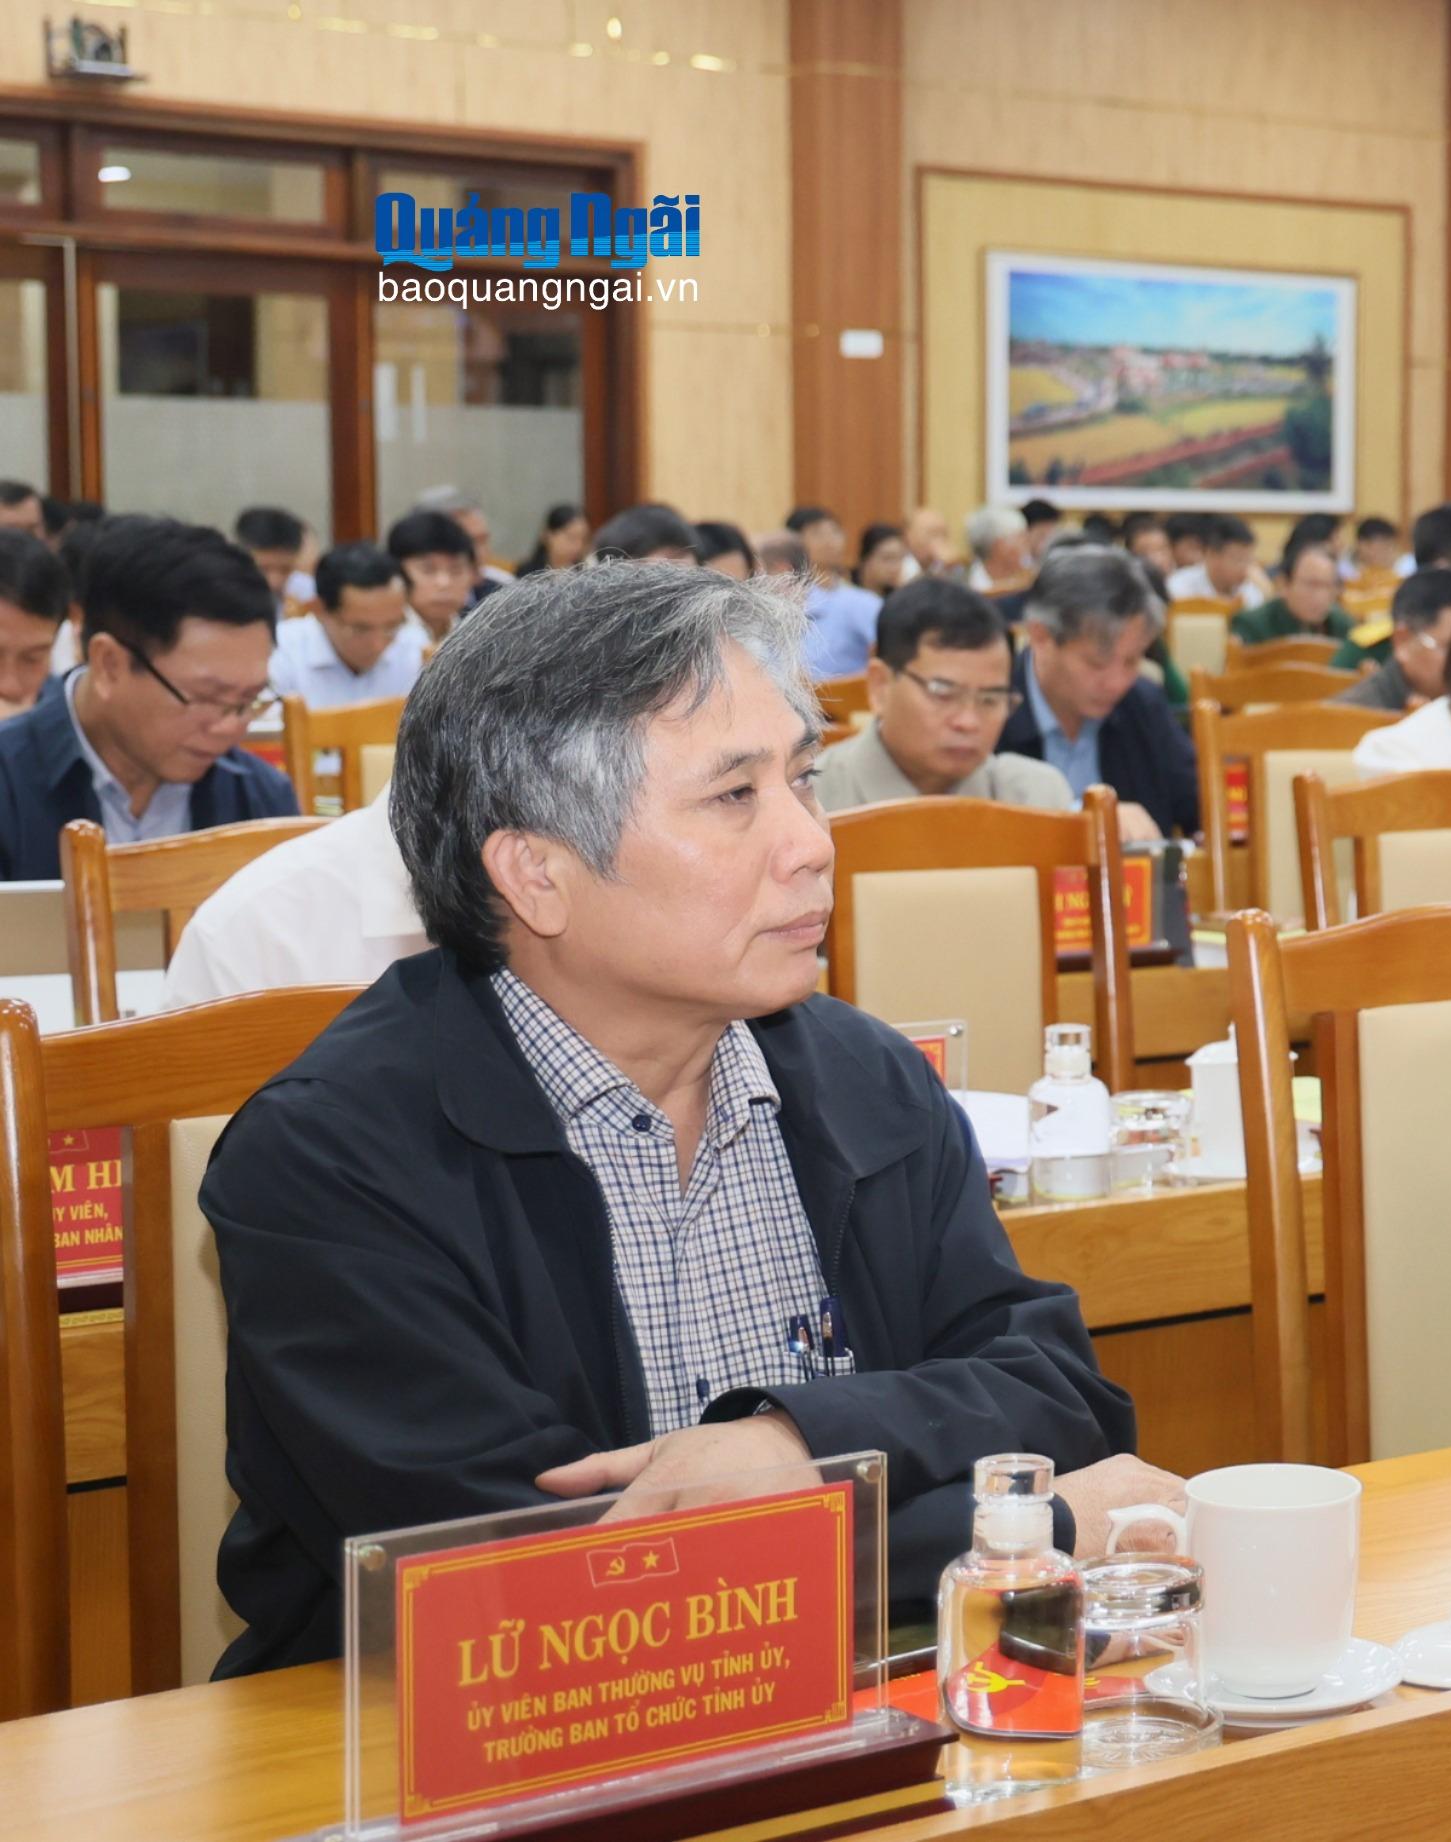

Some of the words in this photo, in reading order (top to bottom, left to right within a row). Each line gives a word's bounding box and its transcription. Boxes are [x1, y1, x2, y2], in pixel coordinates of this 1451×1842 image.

[70, 1200, 108, 1221] VIÊN,
[84, 1223, 123, 1245] NHÂN
[458, 1619, 526, 1686] LỮ
[538, 1601, 671, 1670] NGỌC
[685, 1577, 798, 1640] BÌNH
[467, 1700, 495, 1731] ỦY
[501, 1693, 547, 1724] VIÊN
[553, 1686, 593, 1714] BAN
[598, 1668, 676, 1702] THƯỜNG
[680, 1662, 705, 1688] VỤ
[712, 1650, 754, 1681] TỈNH
[760, 1641, 791, 1671] ỦY,
[484, 1725, 564, 1763] TRƯỞNG
[569, 1717, 609, 1745] BAN
[615, 1699, 640, 1735] TỔ
[646, 1695, 697, 1728] CHỨC
[703, 1686, 745, 1716] TỈNH
[752, 1677, 776, 1707] ỦY
